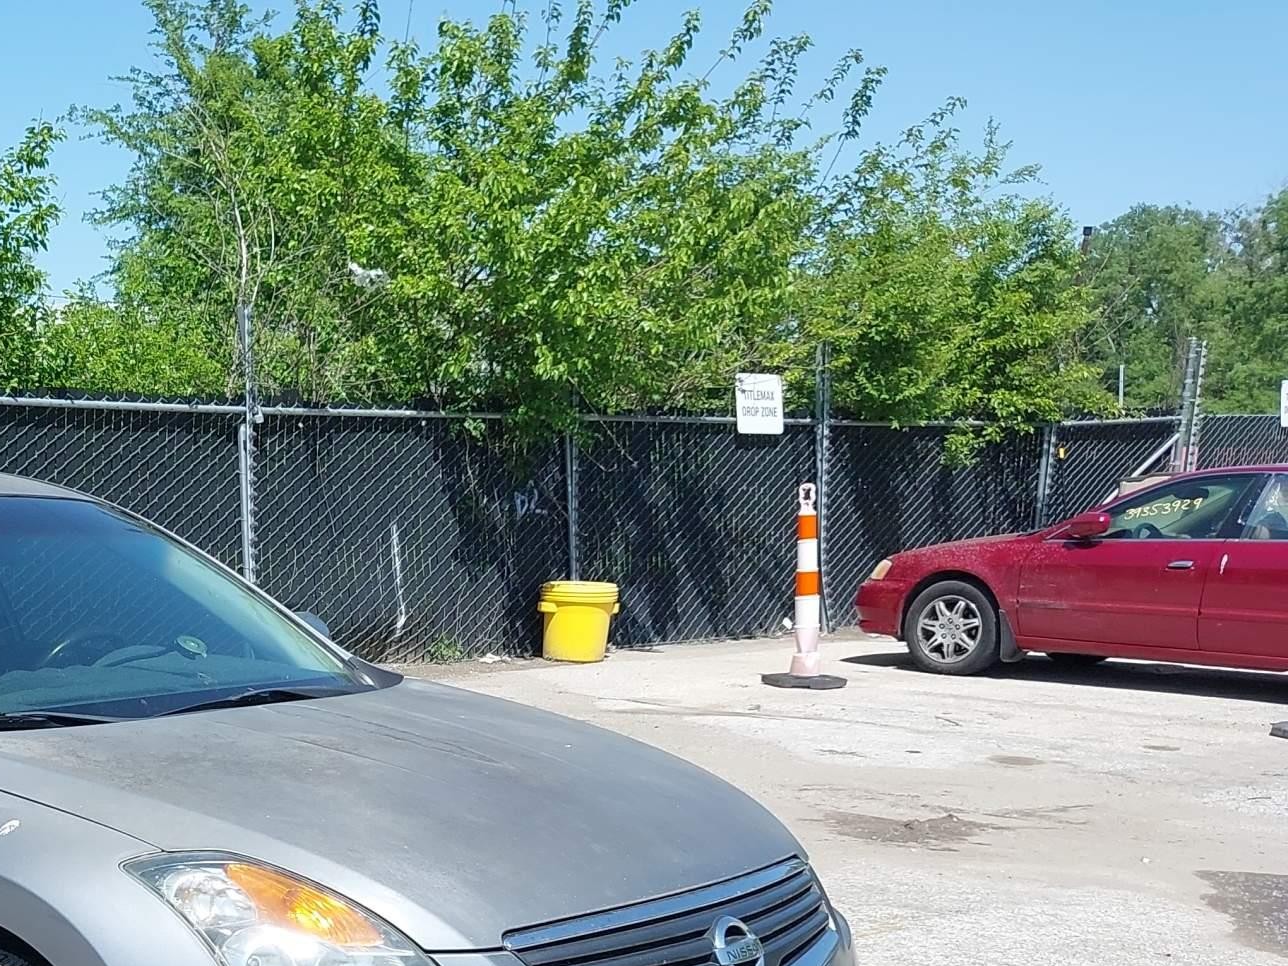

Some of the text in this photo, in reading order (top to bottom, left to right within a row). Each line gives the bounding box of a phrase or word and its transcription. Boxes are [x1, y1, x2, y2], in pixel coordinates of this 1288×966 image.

[742, 406, 777, 417] DROP ZONE
[726, 943, 759, 961] NISS
